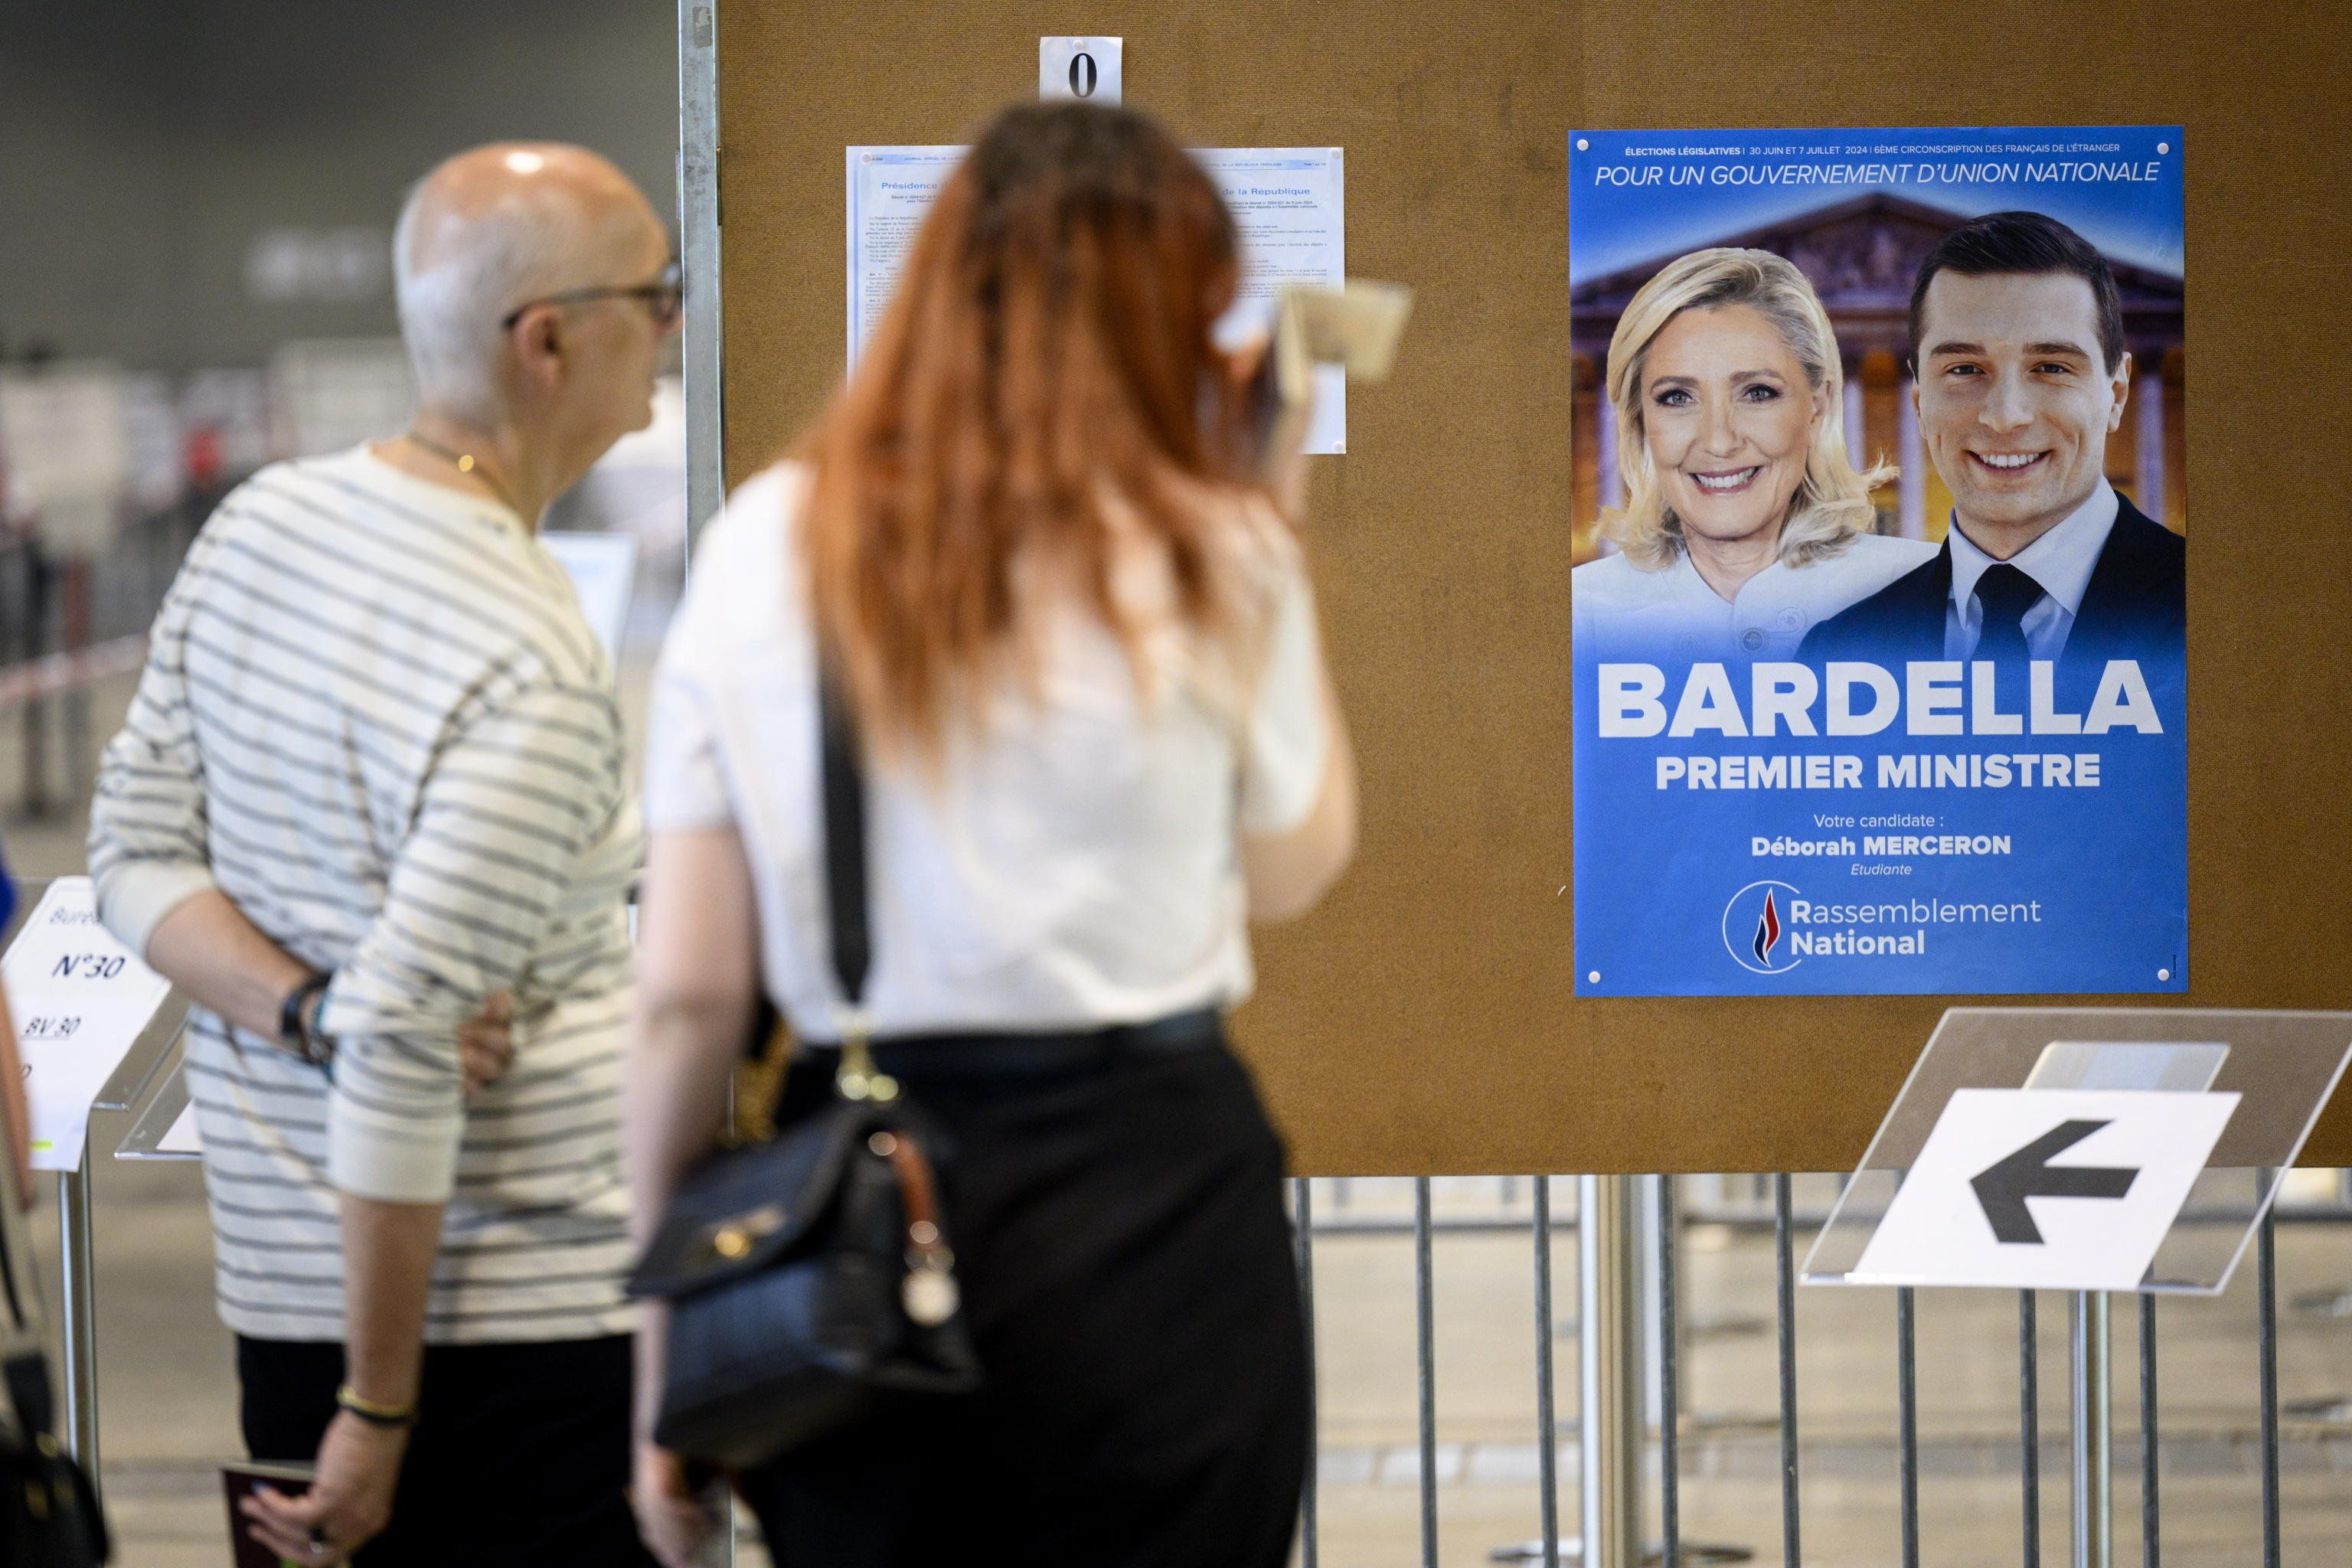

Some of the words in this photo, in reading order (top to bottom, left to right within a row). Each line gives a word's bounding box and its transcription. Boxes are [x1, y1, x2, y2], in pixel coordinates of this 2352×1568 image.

[1625, 146, 1676, 156] ÉLECTIONS
[1677, 145, 1741, 155] LÉGISLATIVES
[1806, 146, 1841, 155] JUILLET
[1900, 145, 1983, 154] CIRCONSCRIPTION
[1985, 145, 2003, 153] DES
[2005, 144, 2050, 154] FRANÇAIS
[2052, 144, 2065, 152] DE
[1595, 166, 1664, 186] POUR
[1670, 165, 1706, 185] UN
[1710, 164, 1913, 185] GOUVERNEMENT
[1917, 162, 2020, 184] D'UNION
[2024, 162, 2161, 182] NATIONALE
[1251, 187, 1311, 197] République
[1598, 660, 2164, 738] BARDELLA
[1656, 755, 1864, 790] PREMIER
[1877, 753, 2100, 788] MINISTRE
[1814, 814, 1854, 828] Votre
[1860, 814, 1935, 828] candidate
[1751, 835, 1856, 857] Déborah
[1864, 835, 2011, 855] MERCERON
[1850, 863, 1913, 877] Etudiante
[1790, 898, 2041, 923] Rassemblement
[1790, 929, 1925, 956] National
[51, 954, 126, 979] N°30
